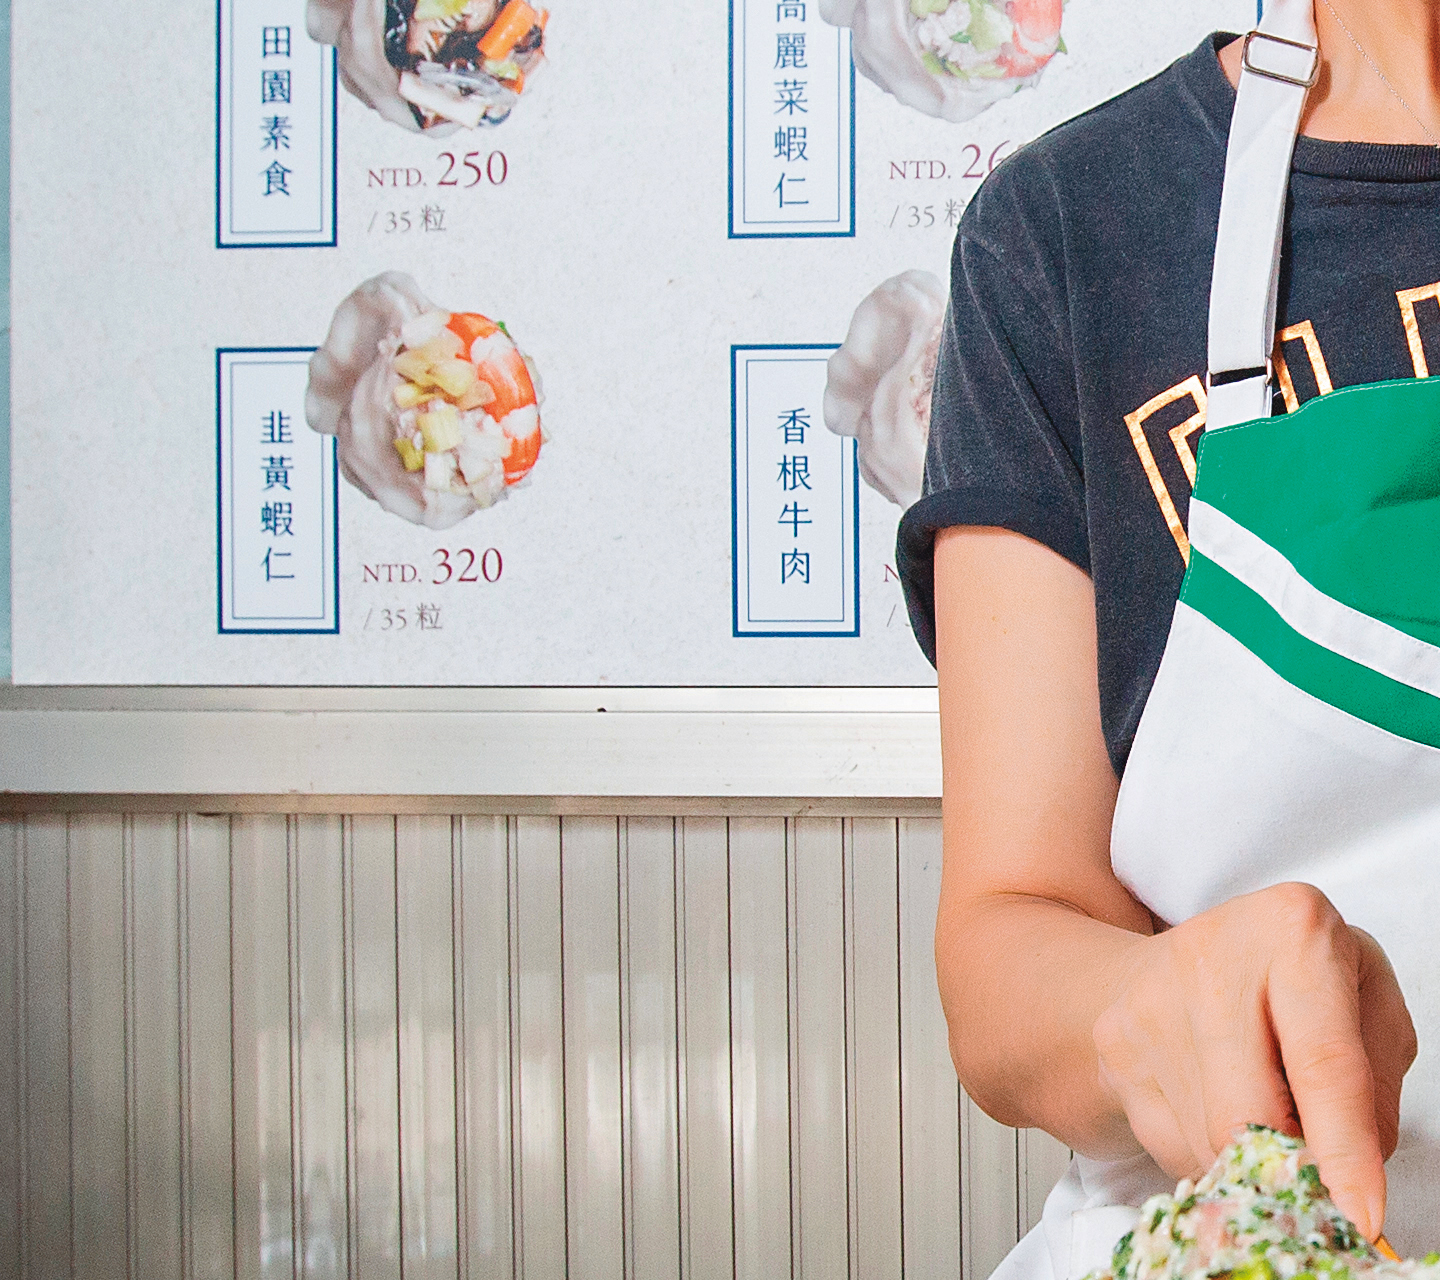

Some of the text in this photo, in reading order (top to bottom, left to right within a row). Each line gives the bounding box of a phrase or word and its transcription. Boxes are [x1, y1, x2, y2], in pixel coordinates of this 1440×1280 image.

[262, 26, 292, 196] 田園素食
[368, 151, 508, 188] NTD. 250
[889, 160, 951, 180] NTD.
[261, 411, 295, 582] 韭黃蝦仁
[778, 408, 812, 584] 香根牛肉
[363, 548, 503, 585] NTD. 320
